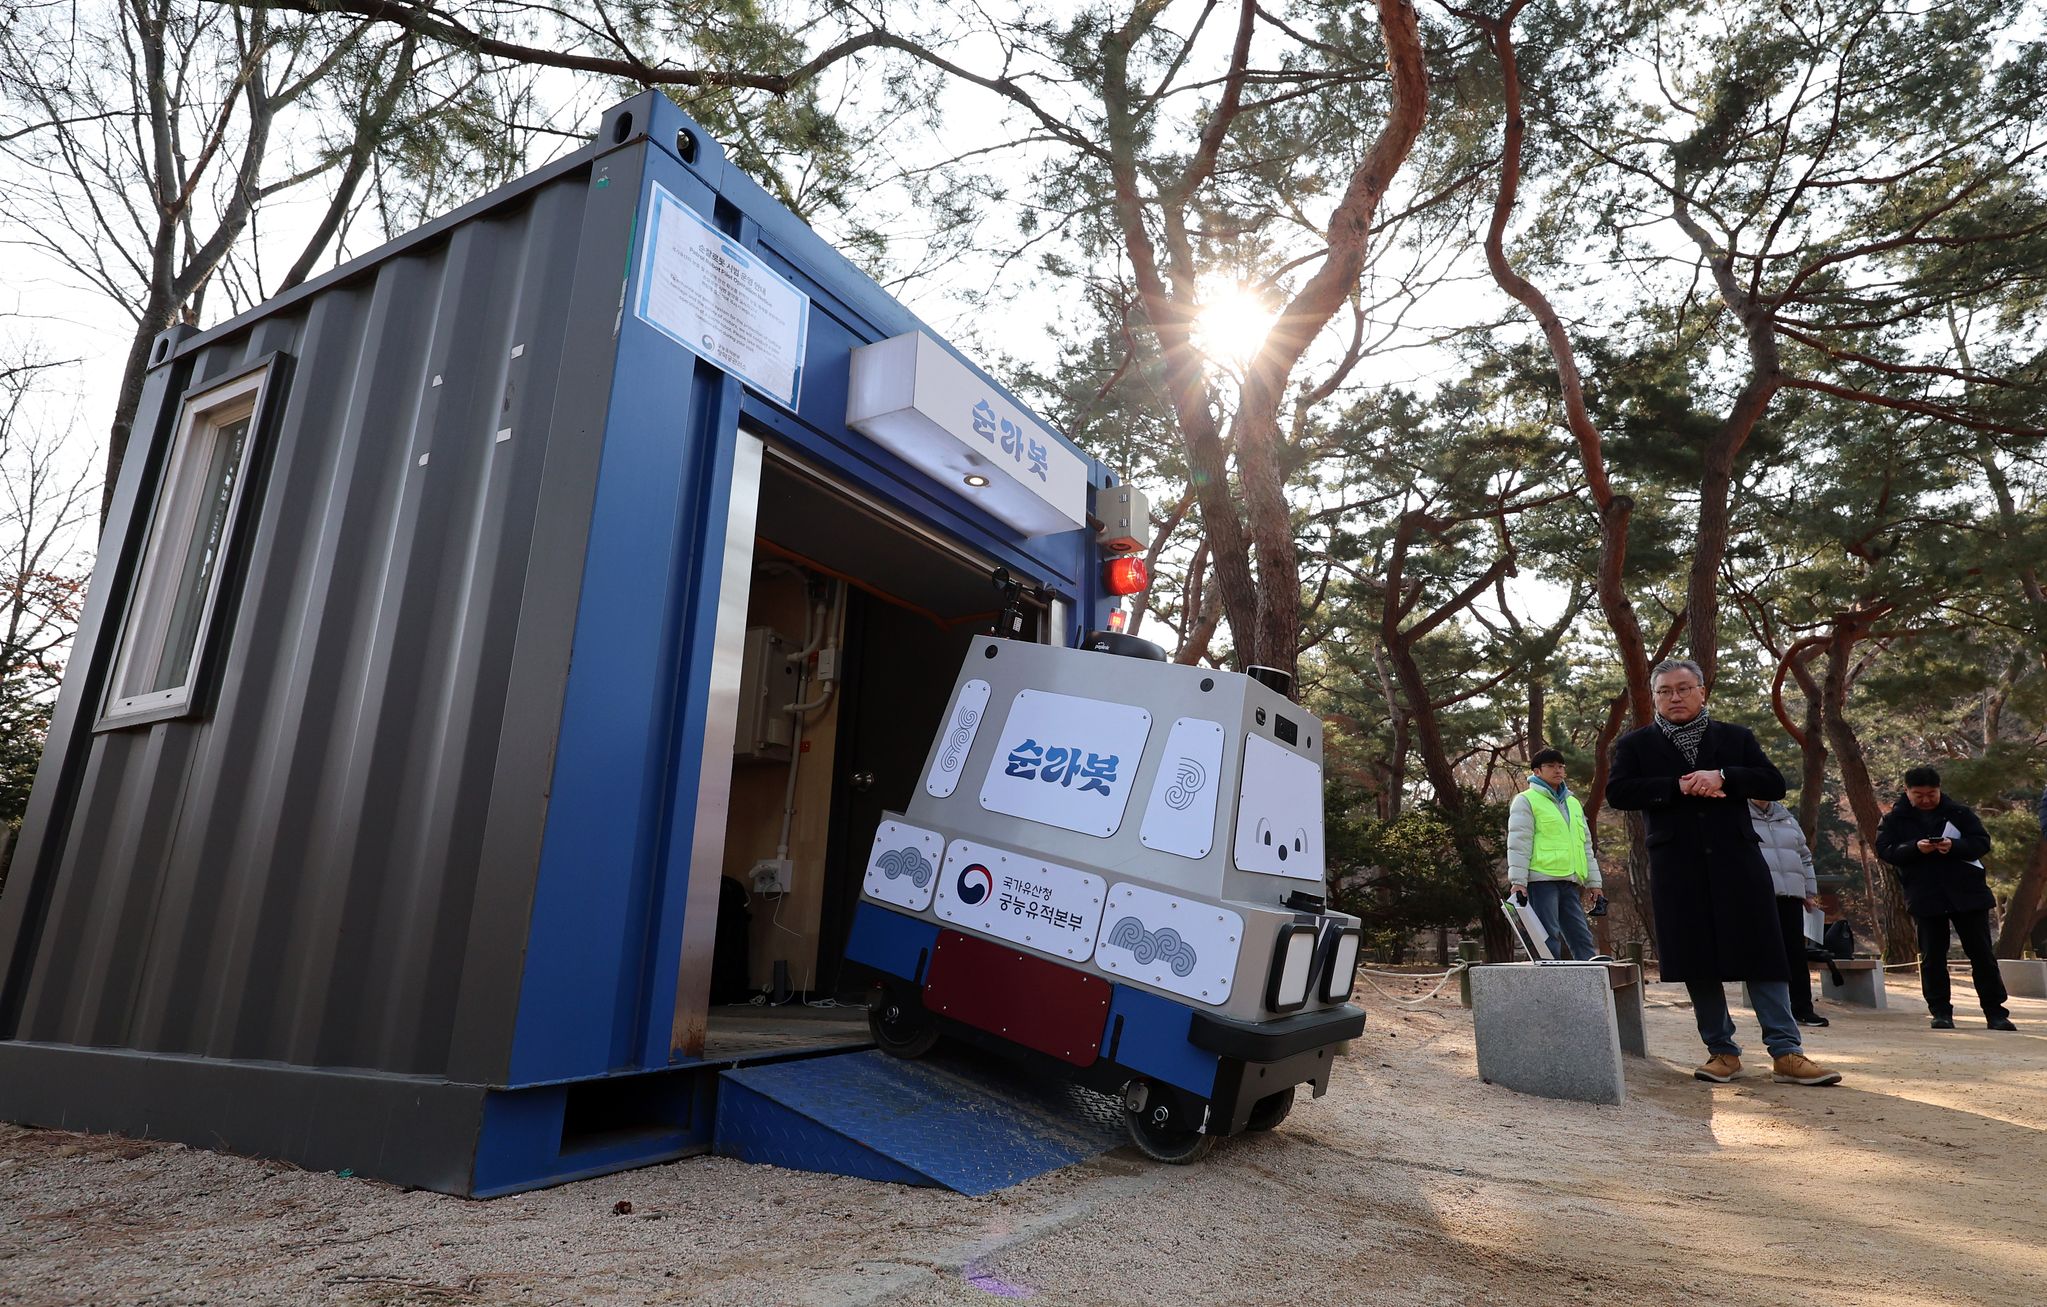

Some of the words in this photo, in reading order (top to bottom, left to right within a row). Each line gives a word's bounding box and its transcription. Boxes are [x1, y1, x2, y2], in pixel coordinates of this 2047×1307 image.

[972, 398, 1048, 482] 순라봇
[1005, 739, 1119, 796] 순라봇
[999, 893, 1083, 931] 궁능유적본부
[1003, 876, 1053, 901] 국가유산청
